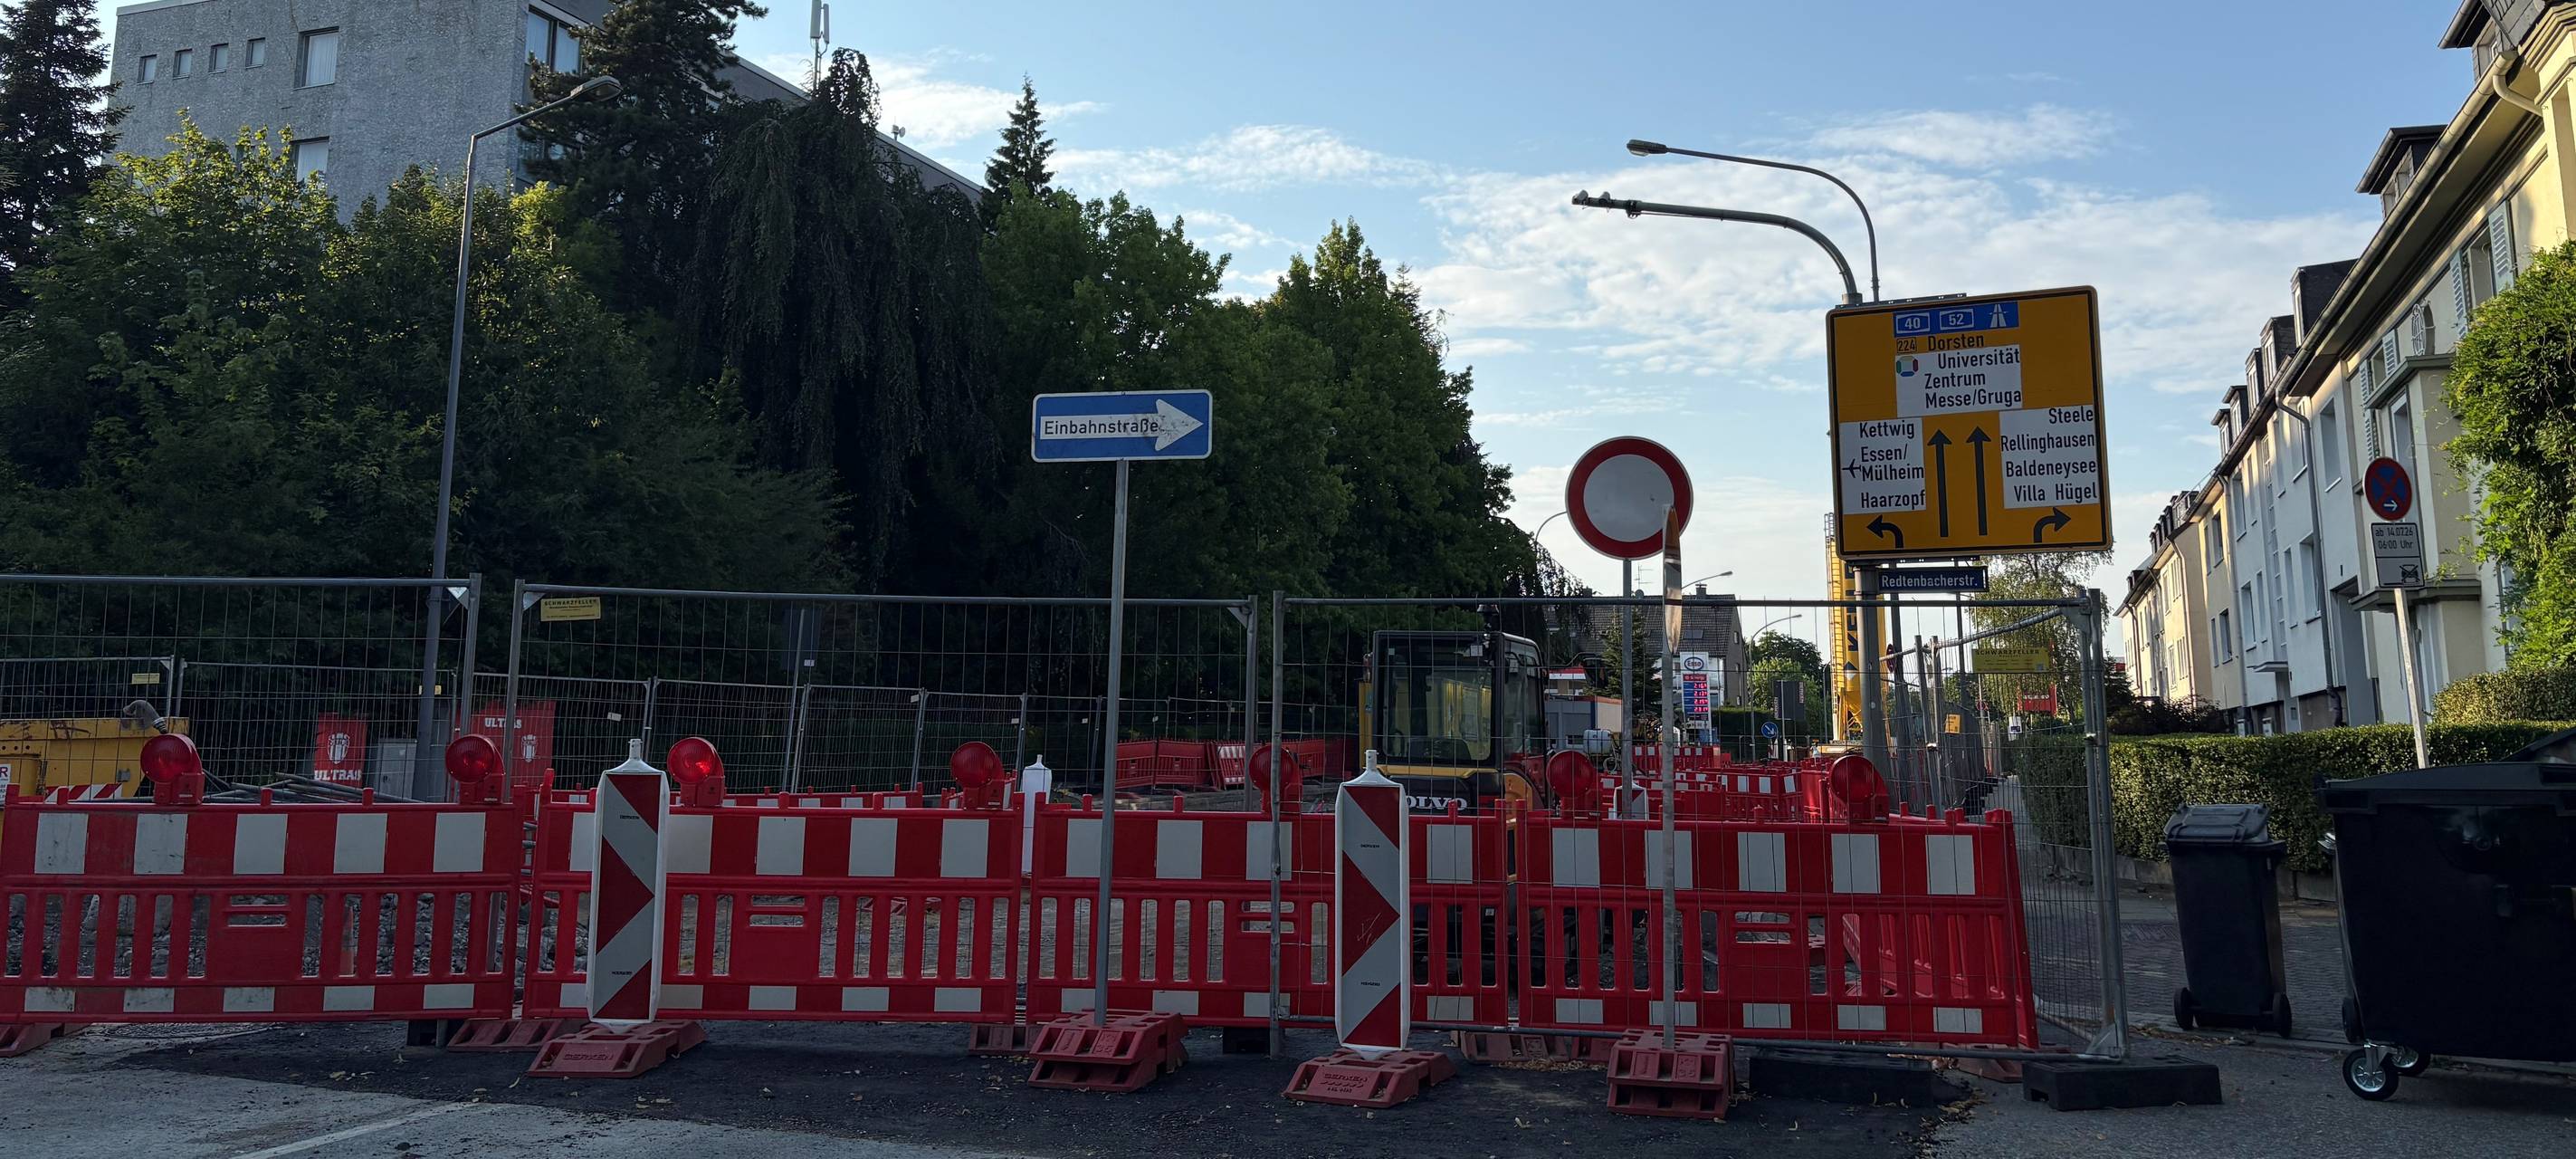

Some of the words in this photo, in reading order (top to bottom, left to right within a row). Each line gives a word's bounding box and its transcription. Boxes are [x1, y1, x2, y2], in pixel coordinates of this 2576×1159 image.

[1904, 317, 1921, 330] 40
[1949, 313, 1965, 326] 52
[1897, 340, 1916, 352] 224
[1927, 334, 1984, 351] Dorsten
[1938, 348, 2020, 369] Universität
[1924, 372, 1986, 389] Zentrum
[1925, 388, 2021, 408] Messe/Gruga
[2048, 406, 2094, 424] Steele
[1045, 417, 1159, 435] Einbahnstraße
[1859, 419, 1914, 439] Kettwig
[2000, 432, 2094, 454] Rellinghausen
[1861, 443, 1908, 463] Essen/
[1862, 463, 1924, 482] Mülheim
[2006, 459, 2096, 479] Baldeneysee
[1861, 489, 1925, 510] Haarzopf
[2014, 484, 2046, 503] Villa
[2055, 482, 2097, 503] Hügel
[2375, 527, 2384, 537] ab
[2400, 539, 2413, 549] Uhr
[1882, 574, 1978, 588] Redtenbacherstr.
[485, 717, 522, 729] ULTS
[1406, 796, 1467, 810] OLVO
